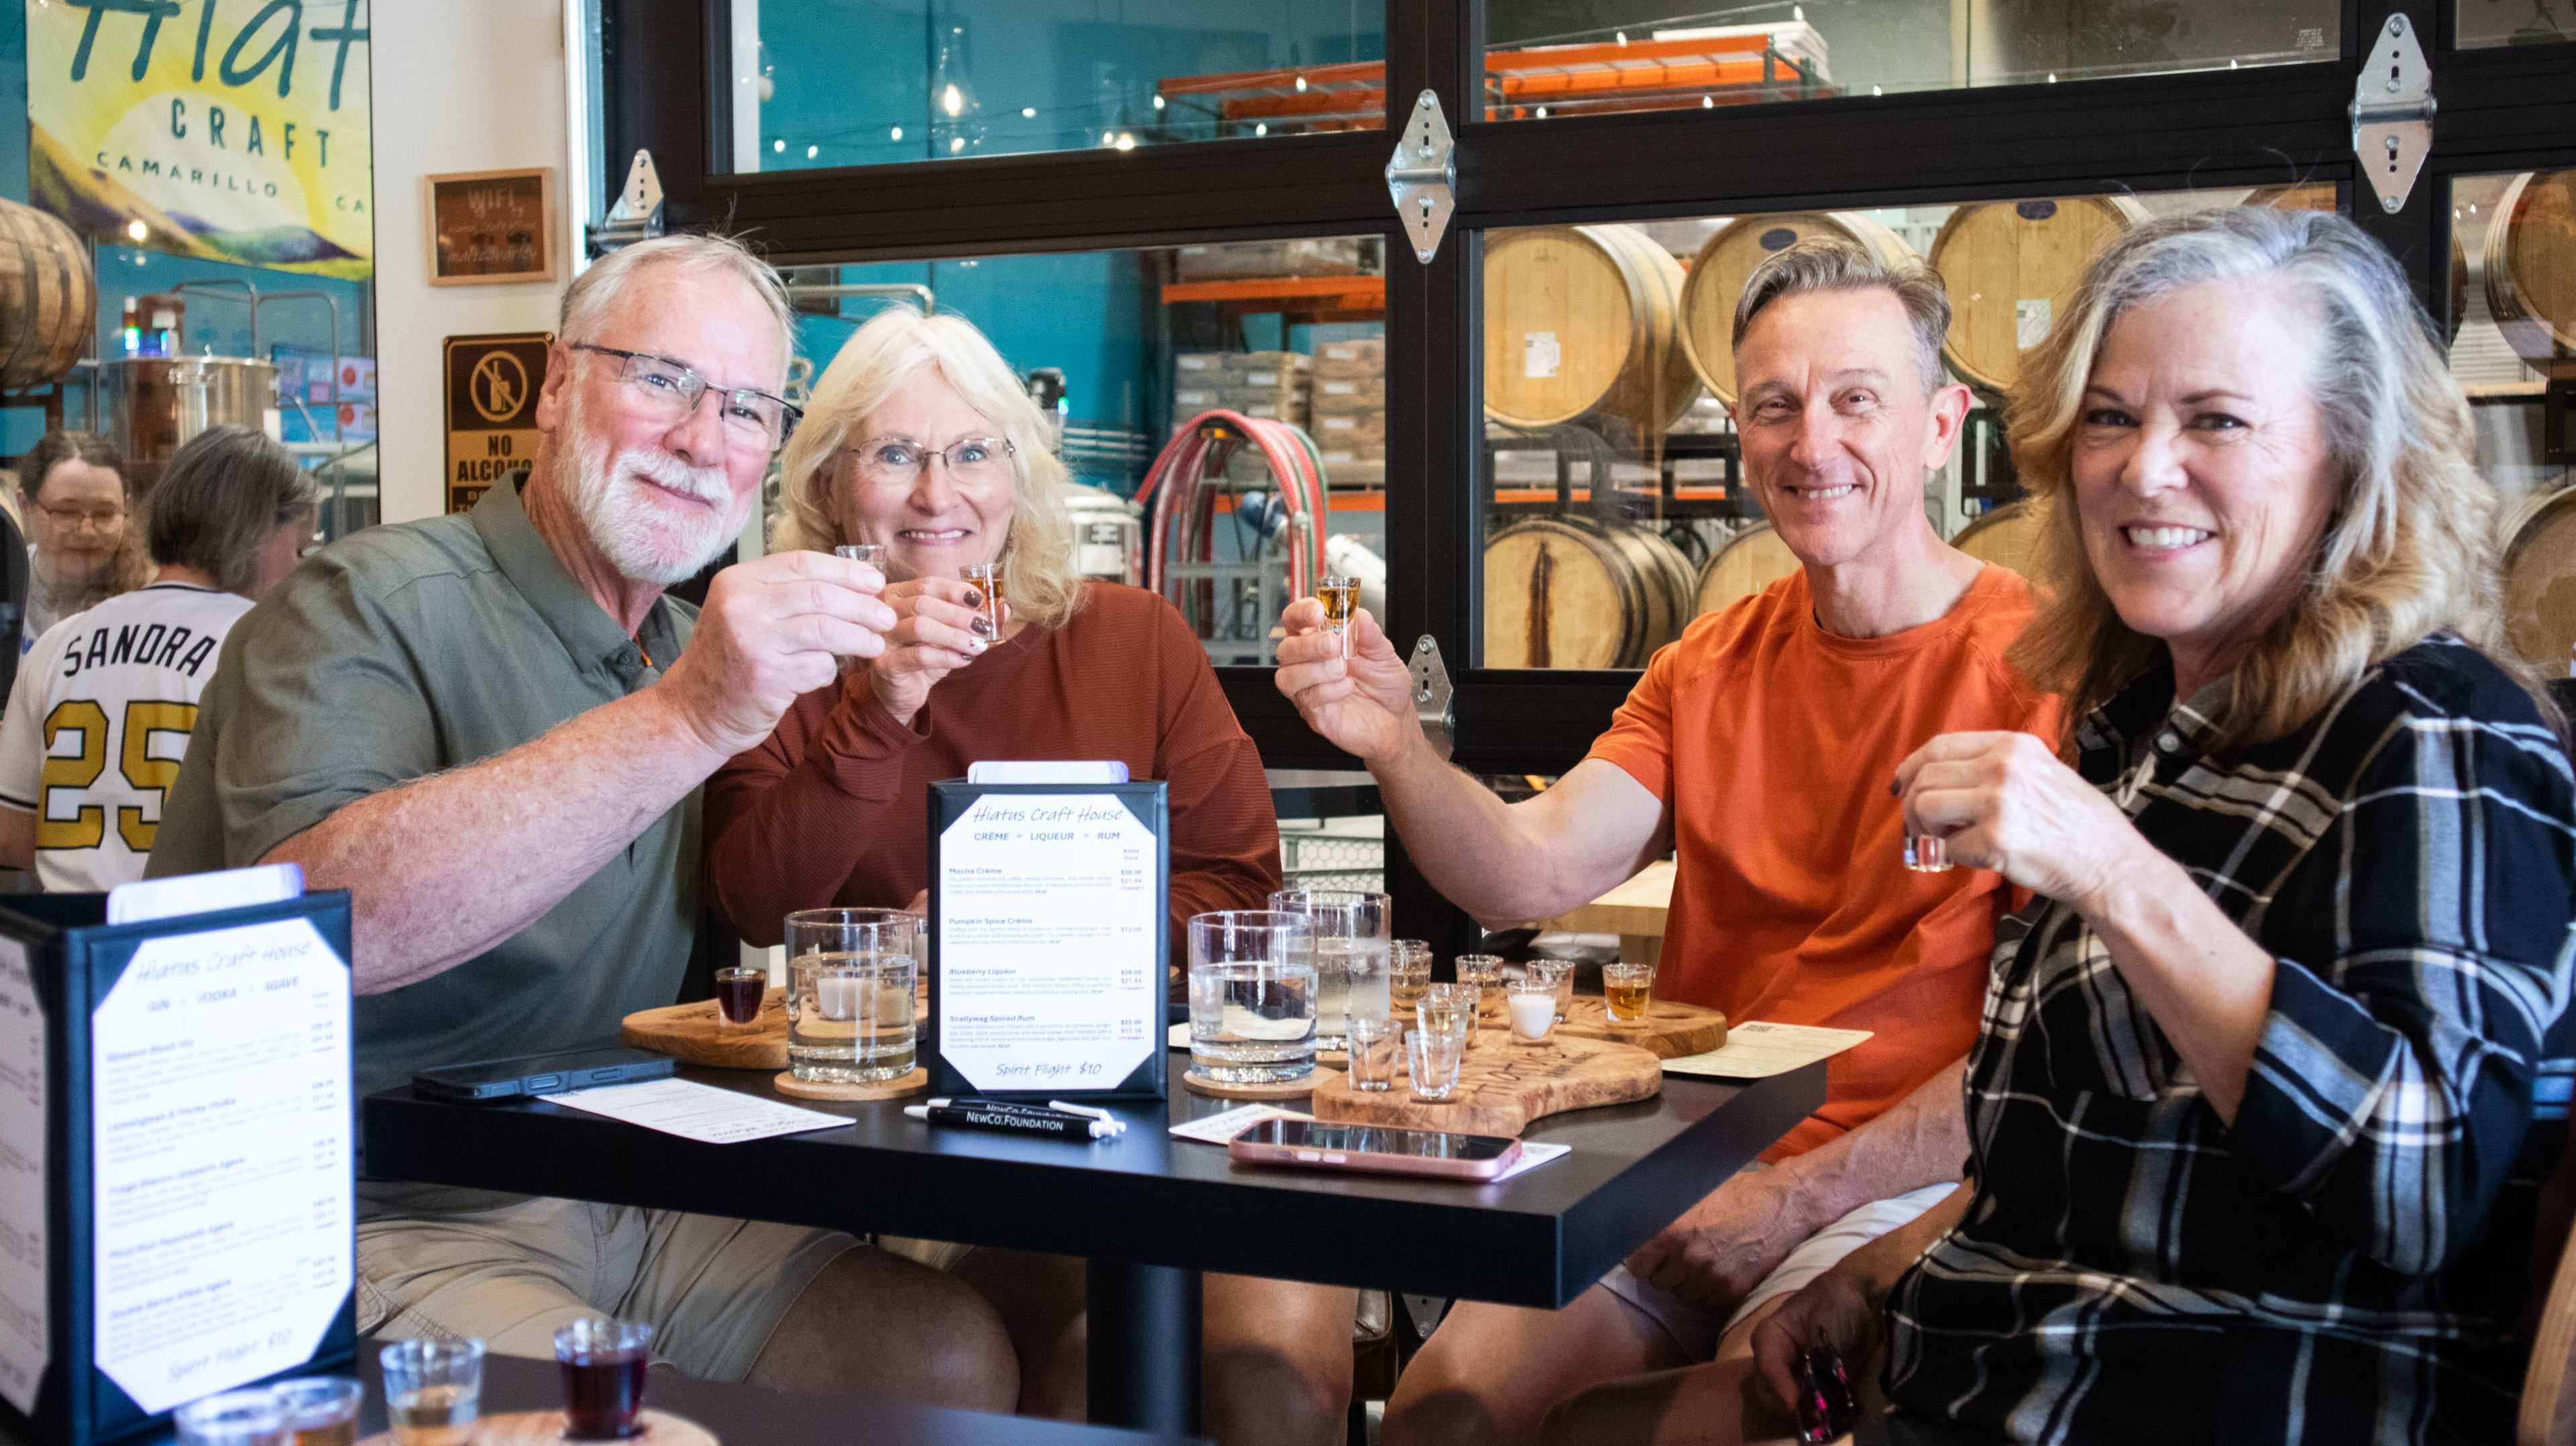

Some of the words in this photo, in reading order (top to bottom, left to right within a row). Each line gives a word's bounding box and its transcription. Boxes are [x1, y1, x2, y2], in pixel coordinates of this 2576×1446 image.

[171, 99, 329, 168] CRAFT
[97, 151, 278, 198] CAMARILLO
[488, 435, 513, 456] NO
[64, 623, 217, 677] SANDRA
[35, 700, 199, 852] 25
[973, 805, 1025, 823] Hiatus
[1030, 807, 1075, 823] Craft
[1077, 805, 1123, 823] House
[1030, 832, 1074, 841] LIQUEUR
[1097, 832, 1120, 840] RUM
[148, 998, 170, 1014] GIN
[196, 988, 237, 1004] VODKA
[265, 976, 300, 992] AGAVE
[996, 1063, 1030, 1076] Spirit
[1034, 1063, 1073, 1079] Flight
[1079, 1062, 1102, 1076] $10
